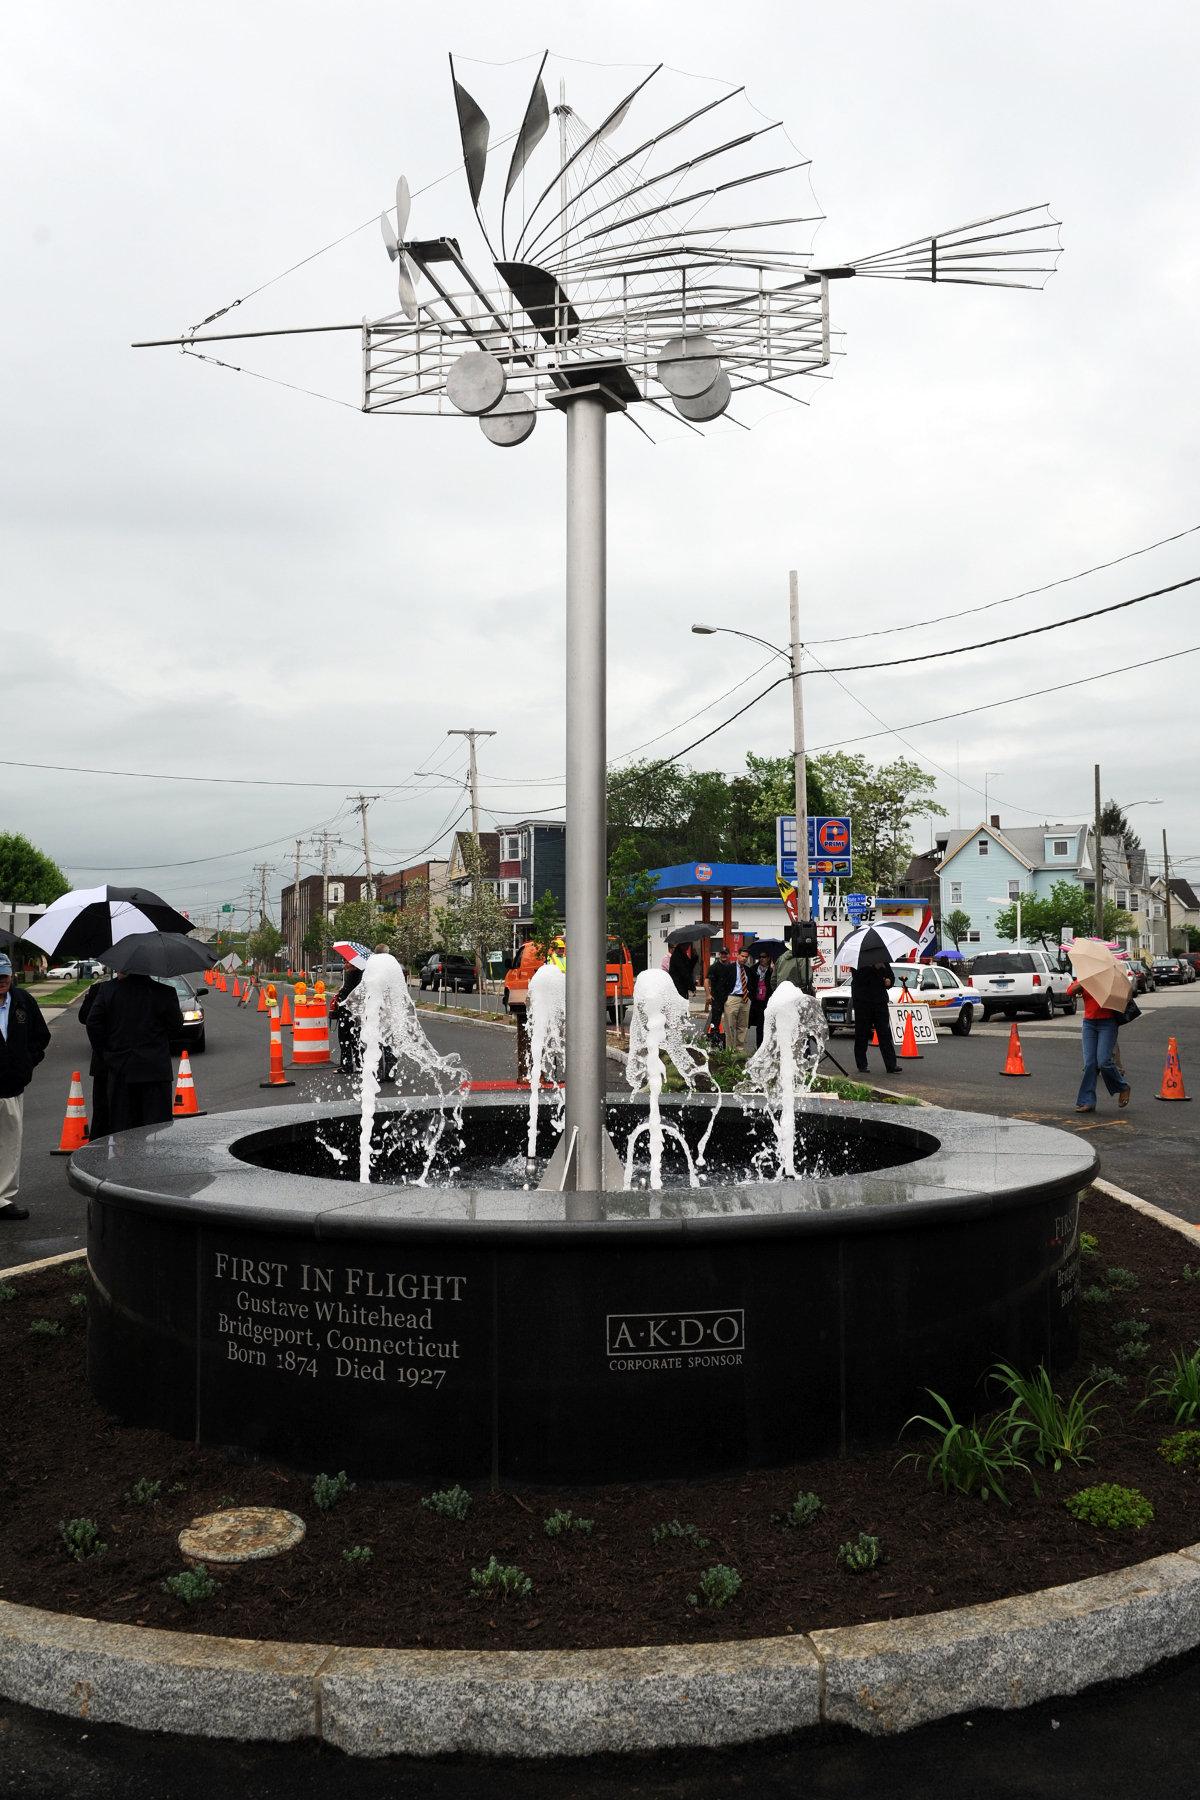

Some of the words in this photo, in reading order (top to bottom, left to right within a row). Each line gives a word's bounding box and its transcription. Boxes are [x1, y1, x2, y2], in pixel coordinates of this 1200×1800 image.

[844, 910, 877, 921] LBE
[817, 927, 833, 936] EN
[897, 1009, 922, 1021] ROAD
[895, 1026, 932, 1038] CLSED
[1054, 1208, 1075, 1240] FIRST
[214, 1252, 288, 1288] FIRST
[300, 1264, 334, 1294] IN
[345, 1268, 467, 1301] FLIGHT
[236, 1290, 309, 1319] Gustave
[314, 1301, 433, 1330] Whitehead
[218, 1313, 321, 1351] Bridgeport,
[326, 1329, 460, 1359] Connecticut
[227, 1341, 266, 1366] Born
[276, 1350, 318, 1378] 1874
[335, 1357, 385, 1381] Died
[397, 1367, 446, 1389] 1927
[609, 1357, 682, 1371] CORPORATE
[688, 1354, 743, 1368] SPONSOR
